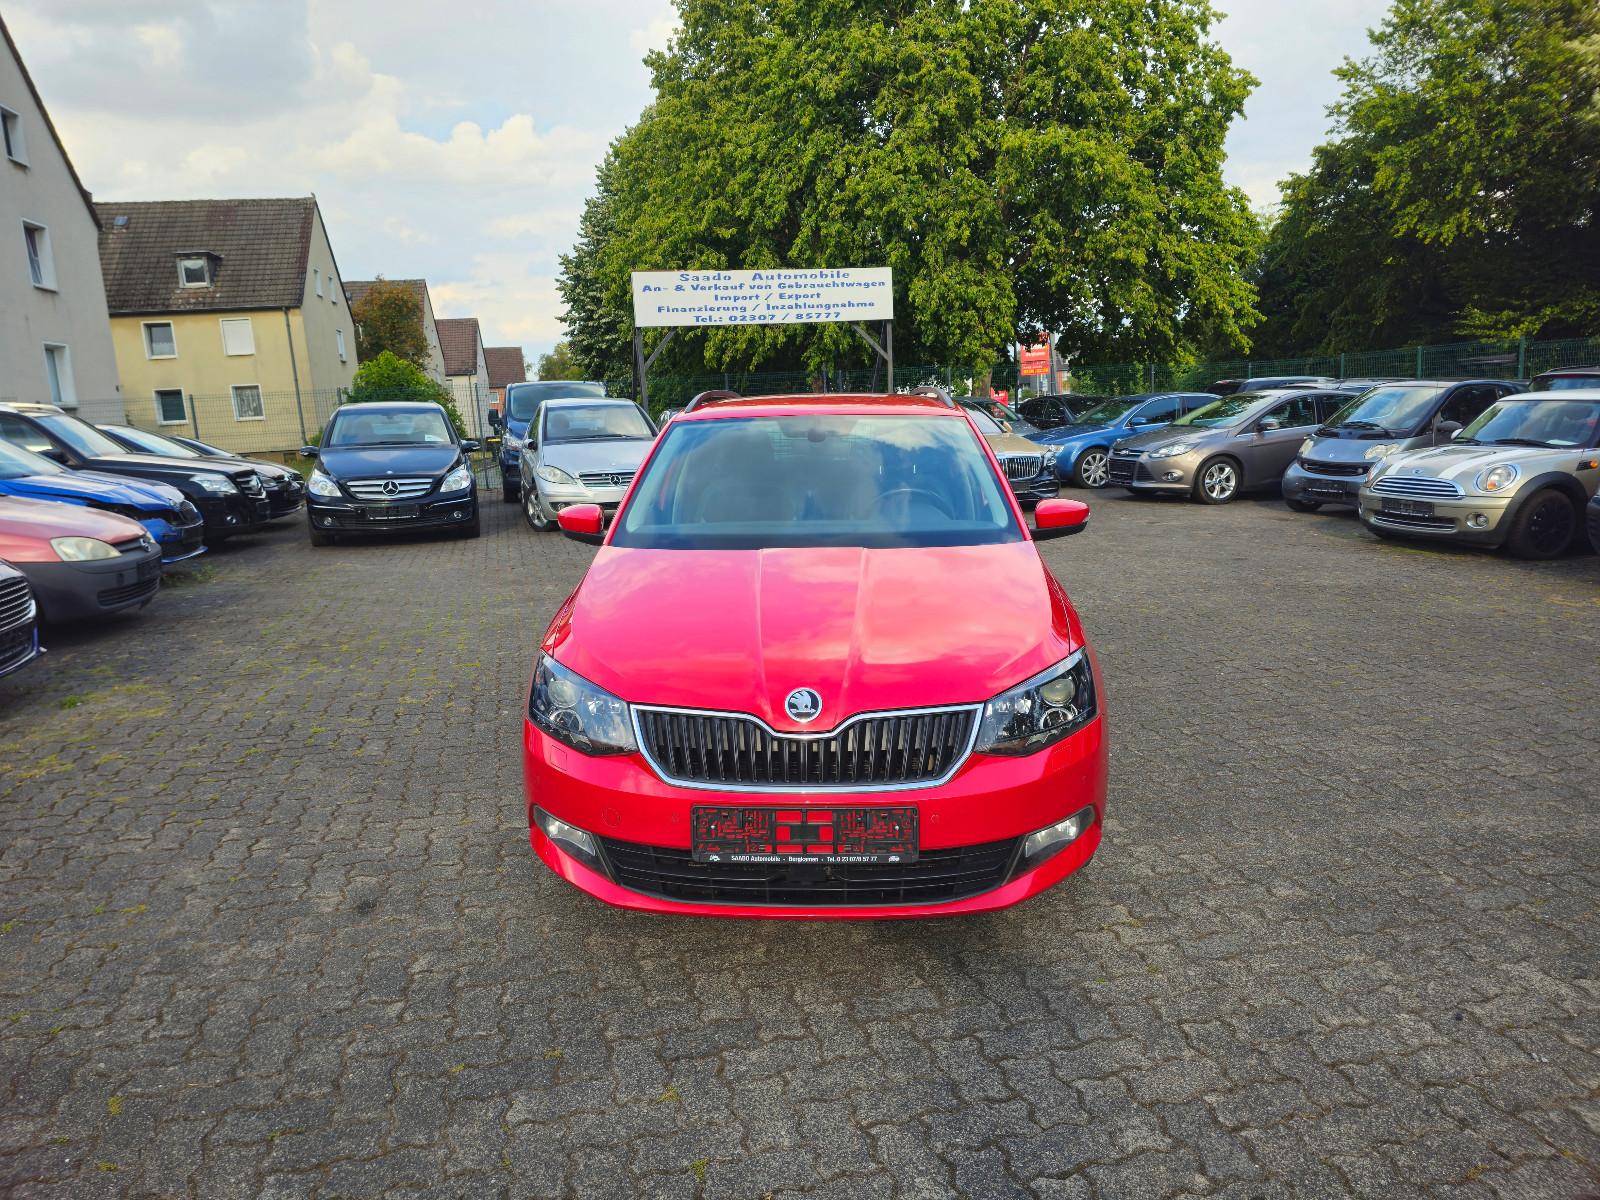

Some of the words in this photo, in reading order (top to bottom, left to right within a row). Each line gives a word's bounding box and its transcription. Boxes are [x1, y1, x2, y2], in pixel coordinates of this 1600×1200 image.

[680, 273, 732, 282] Saado
[752, 270, 850, 281] Automobile
[642, 284, 668, 293] An-
[674, 284, 686, 292] &
[690, 282, 746, 291] Verkauf
[777, 280, 886, 289] Gebrauchtwagen
[714, 294, 760, 303] Import
[778, 292, 822, 301] Export
[657, 305, 747, 313] Finanzierung
[766, 300, 876, 311] Inzahlungnahme
[693, 315, 723, 323] Tel.:
[728, 314, 776, 322] 02307
[795, 312, 841, 320] 85777
